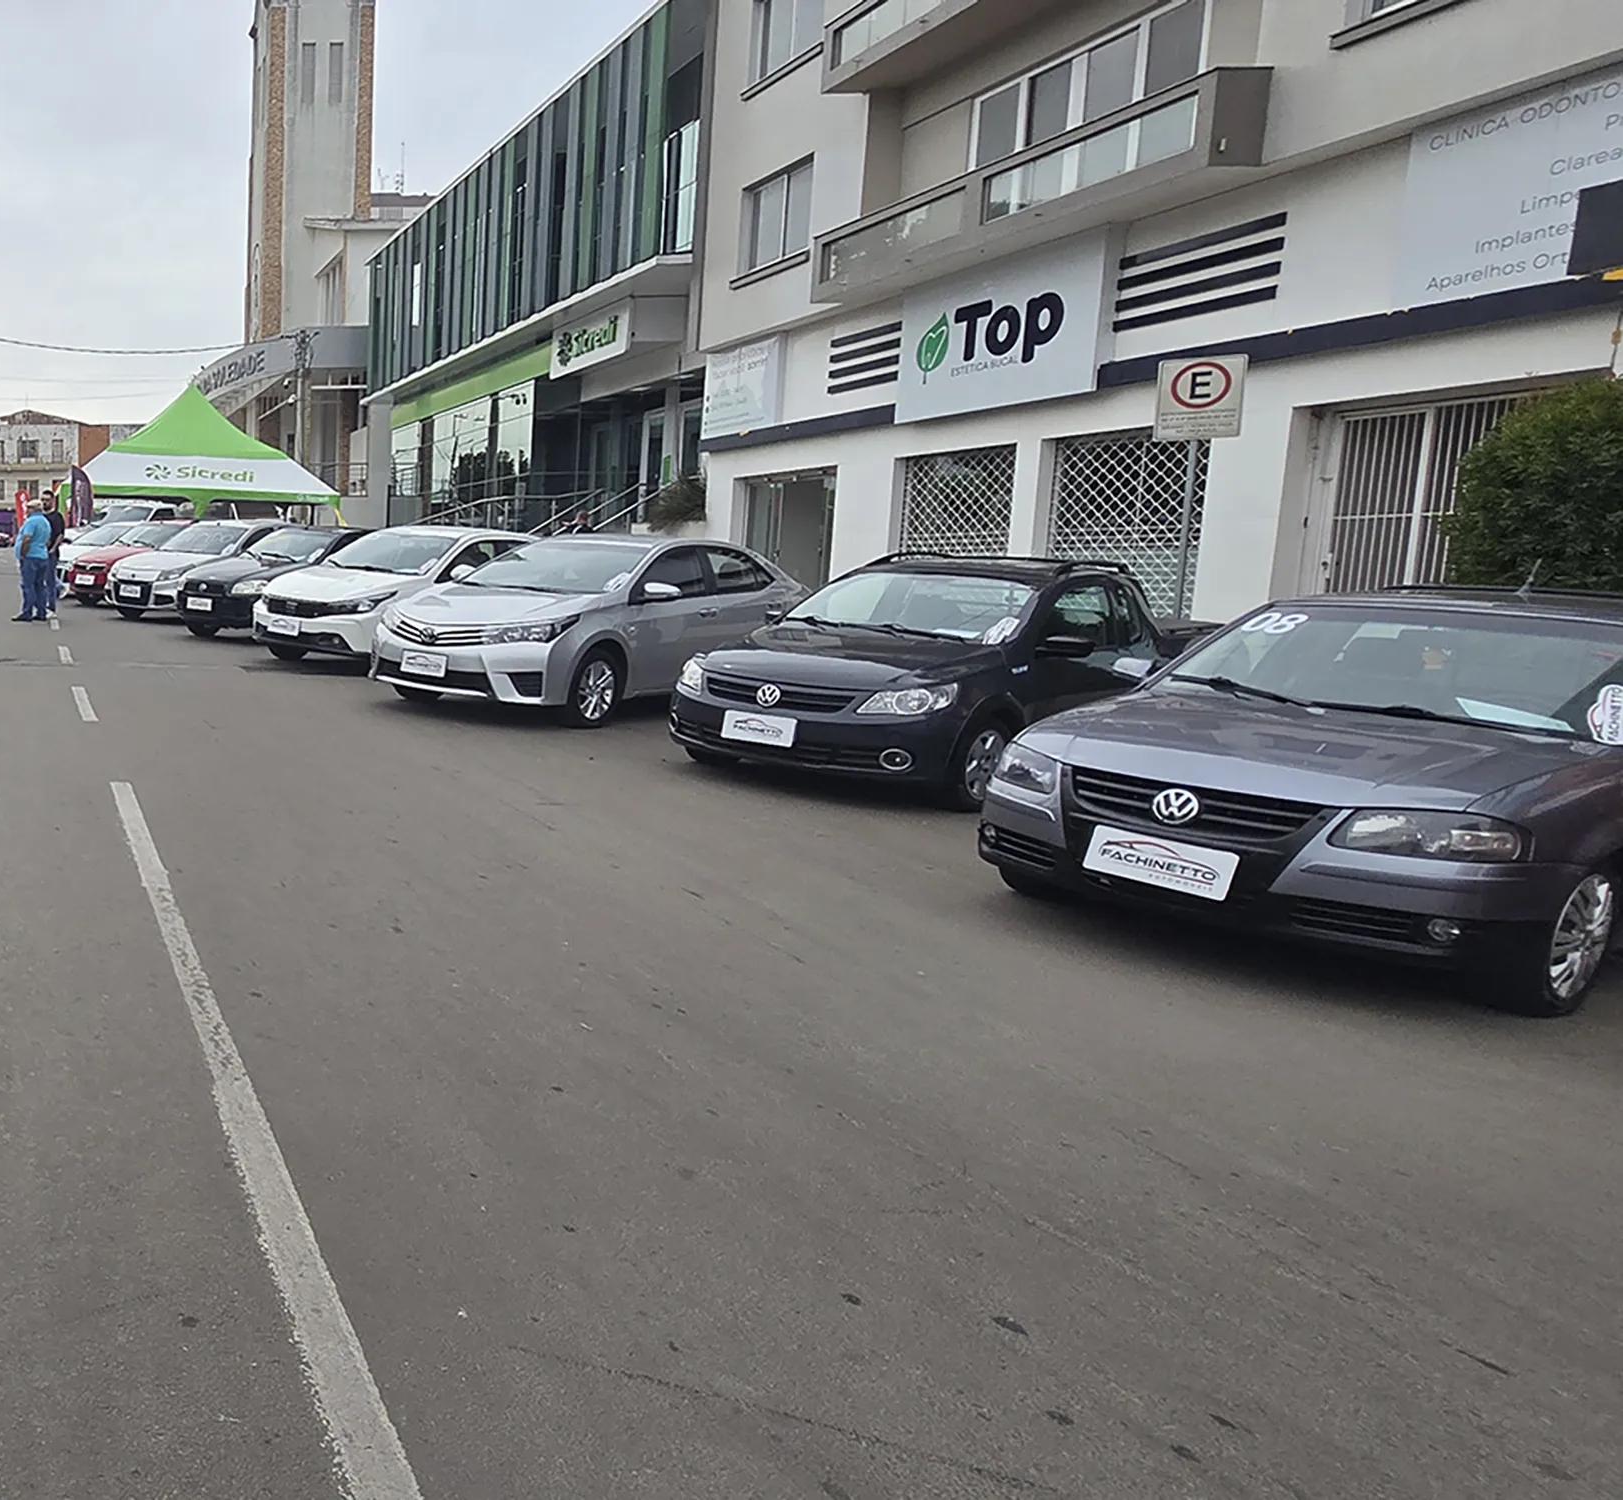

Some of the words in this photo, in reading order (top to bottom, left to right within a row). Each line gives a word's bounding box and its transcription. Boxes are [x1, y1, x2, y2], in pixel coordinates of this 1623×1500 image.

[1426, 260, 1526, 292] Aparelhos
[954, 292, 1064, 363] Top
[1189, 370, 1213, 400] E
[176, 466, 256, 483] Sicredi
[1241, 611, 1309, 634] 08
[1100, 848, 1217, 882] FACHINETTO
